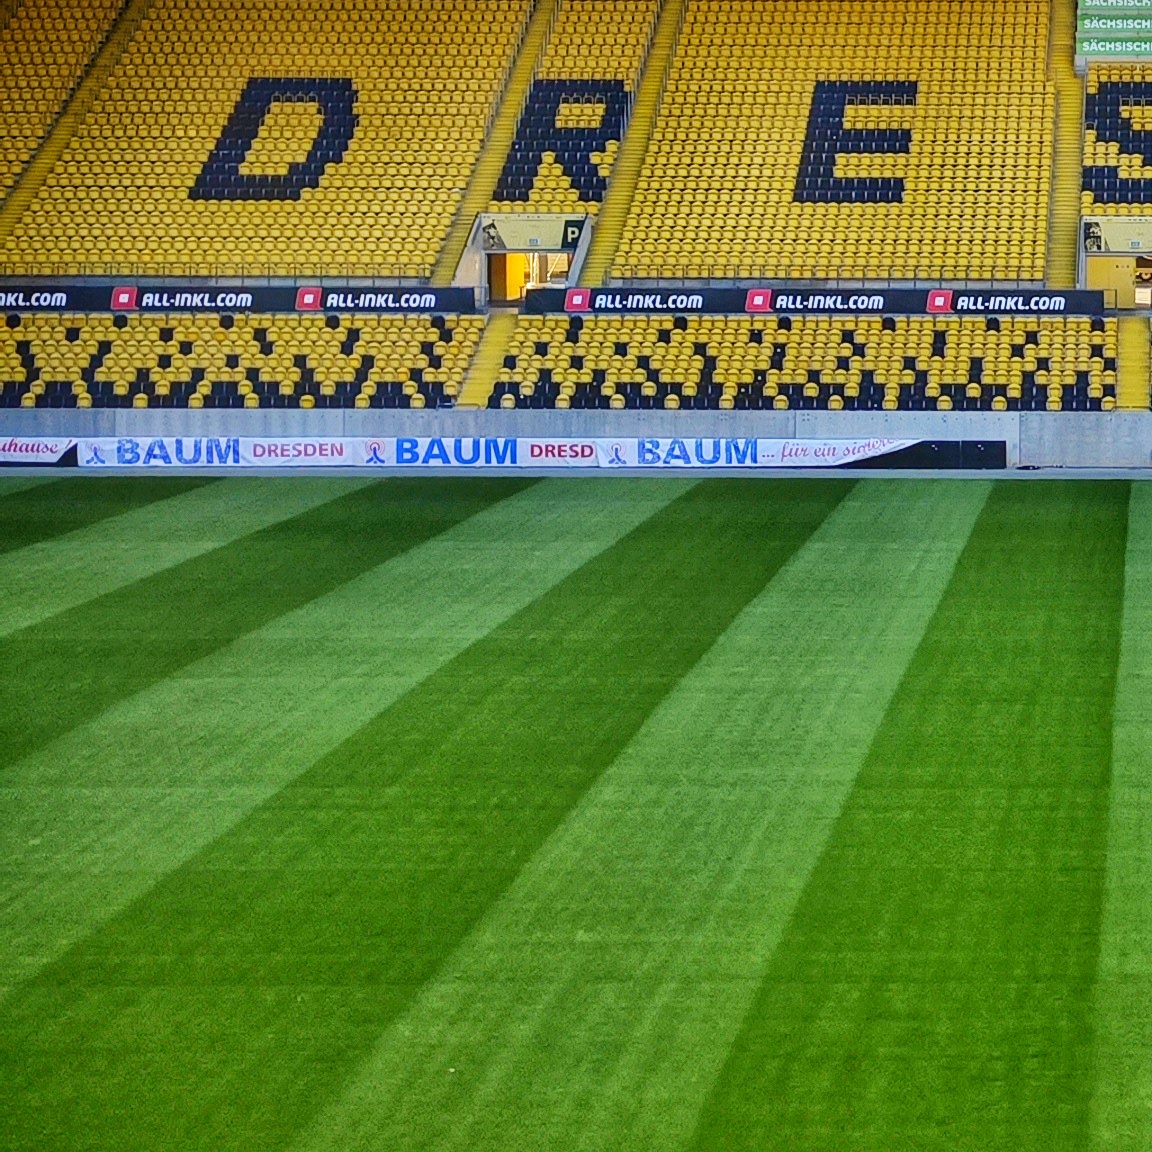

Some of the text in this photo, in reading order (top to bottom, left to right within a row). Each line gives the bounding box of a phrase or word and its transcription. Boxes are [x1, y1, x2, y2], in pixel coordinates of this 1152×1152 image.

[567, 227, 579, 242] P
[142, 293, 253, 307] ALL-INKL.COM
[326, 293, 436, 308] ALL-INKL.COM
[594, 294, 703, 308] ALL-INKL.COM
[775, 295, 884, 309] ALL-INKL.COM
[956, 296, 1066, 310] ALL-INKL.COM
[116, 438, 344, 464] BAUM DRESDEN
[396, 438, 594, 464] BAUM DRESD
[637, 438, 758, 465] BAUM
[781, 442, 809, 461] für
[813, 442, 838, 457] ein
